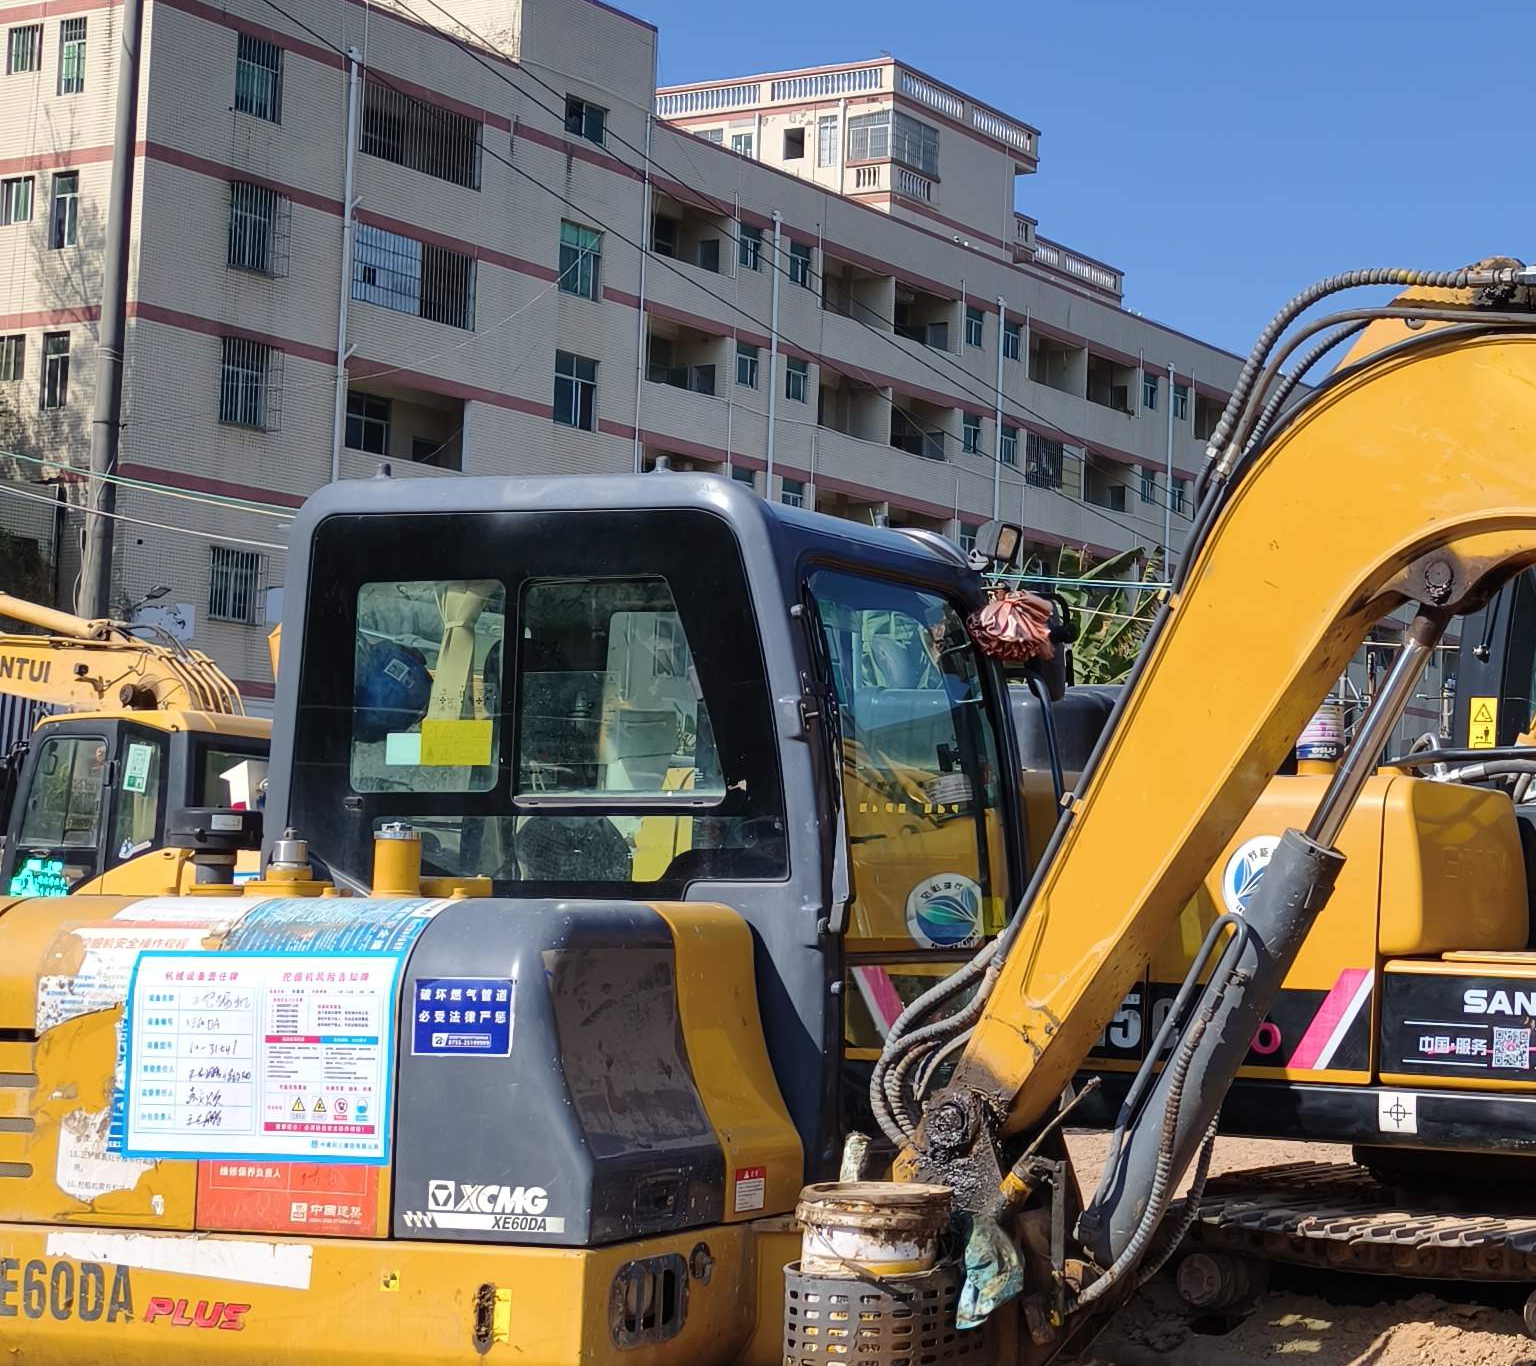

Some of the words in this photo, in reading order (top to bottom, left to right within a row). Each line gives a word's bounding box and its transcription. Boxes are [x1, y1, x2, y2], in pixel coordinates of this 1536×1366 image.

[0, 655, 51, 683] NTUI
[420, 988, 507, 1002] 破坏燃气管道
[418, 1010, 507, 1024] 必受法律严惩
[453, 1184, 549, 1215] XCMG
[491, 1215, 547, 1232] XE60DA
[0, 1257, 135, 1324] E60DA
[144, 1296, 252, 1332] PLUS
